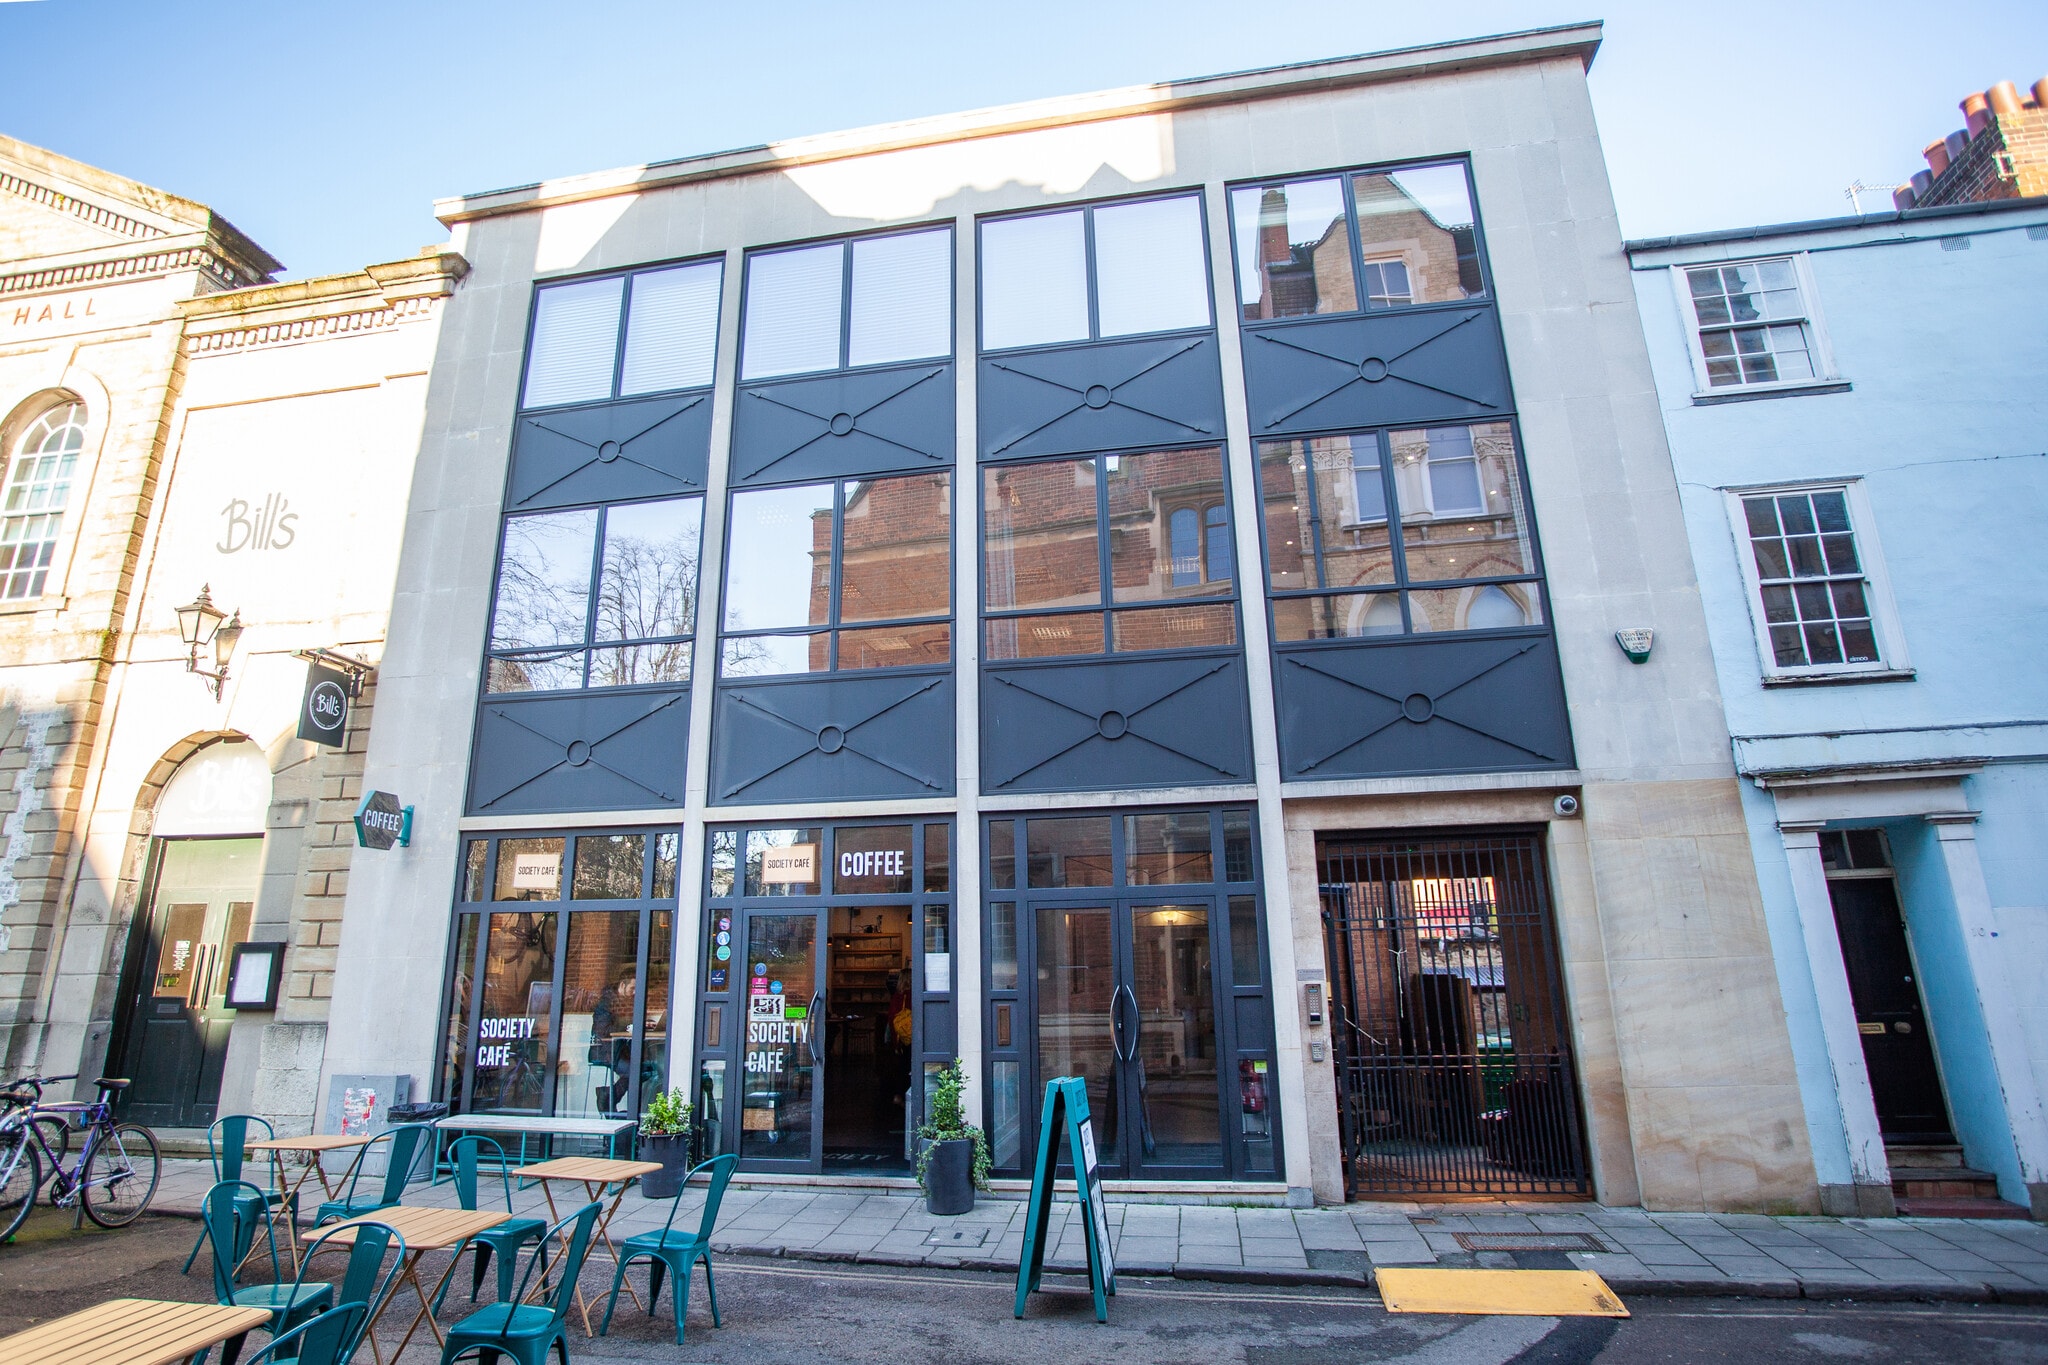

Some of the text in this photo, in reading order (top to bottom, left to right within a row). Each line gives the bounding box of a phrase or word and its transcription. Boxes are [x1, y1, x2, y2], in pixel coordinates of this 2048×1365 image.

[13, 297, 97, 326] HALL
[216, 492, 299, 554] Bill's
[316, 693, 340, 716] Bill's
[364, 809, 400, 832] COFFEE
[518, 866, 540, 875] SOCIETY
[767, 857, 810, 869] SOCIETY CAFÉ
[841, 850, 905, 877] COFFEE
[480, 1018, 536, 1039] SOCIETY
[749, 1022, 808, 1044] SOCIETY
[477, 1041, 512, 1066] CAFÉ
[748, 1047, 784, 1073] CAFÉ
